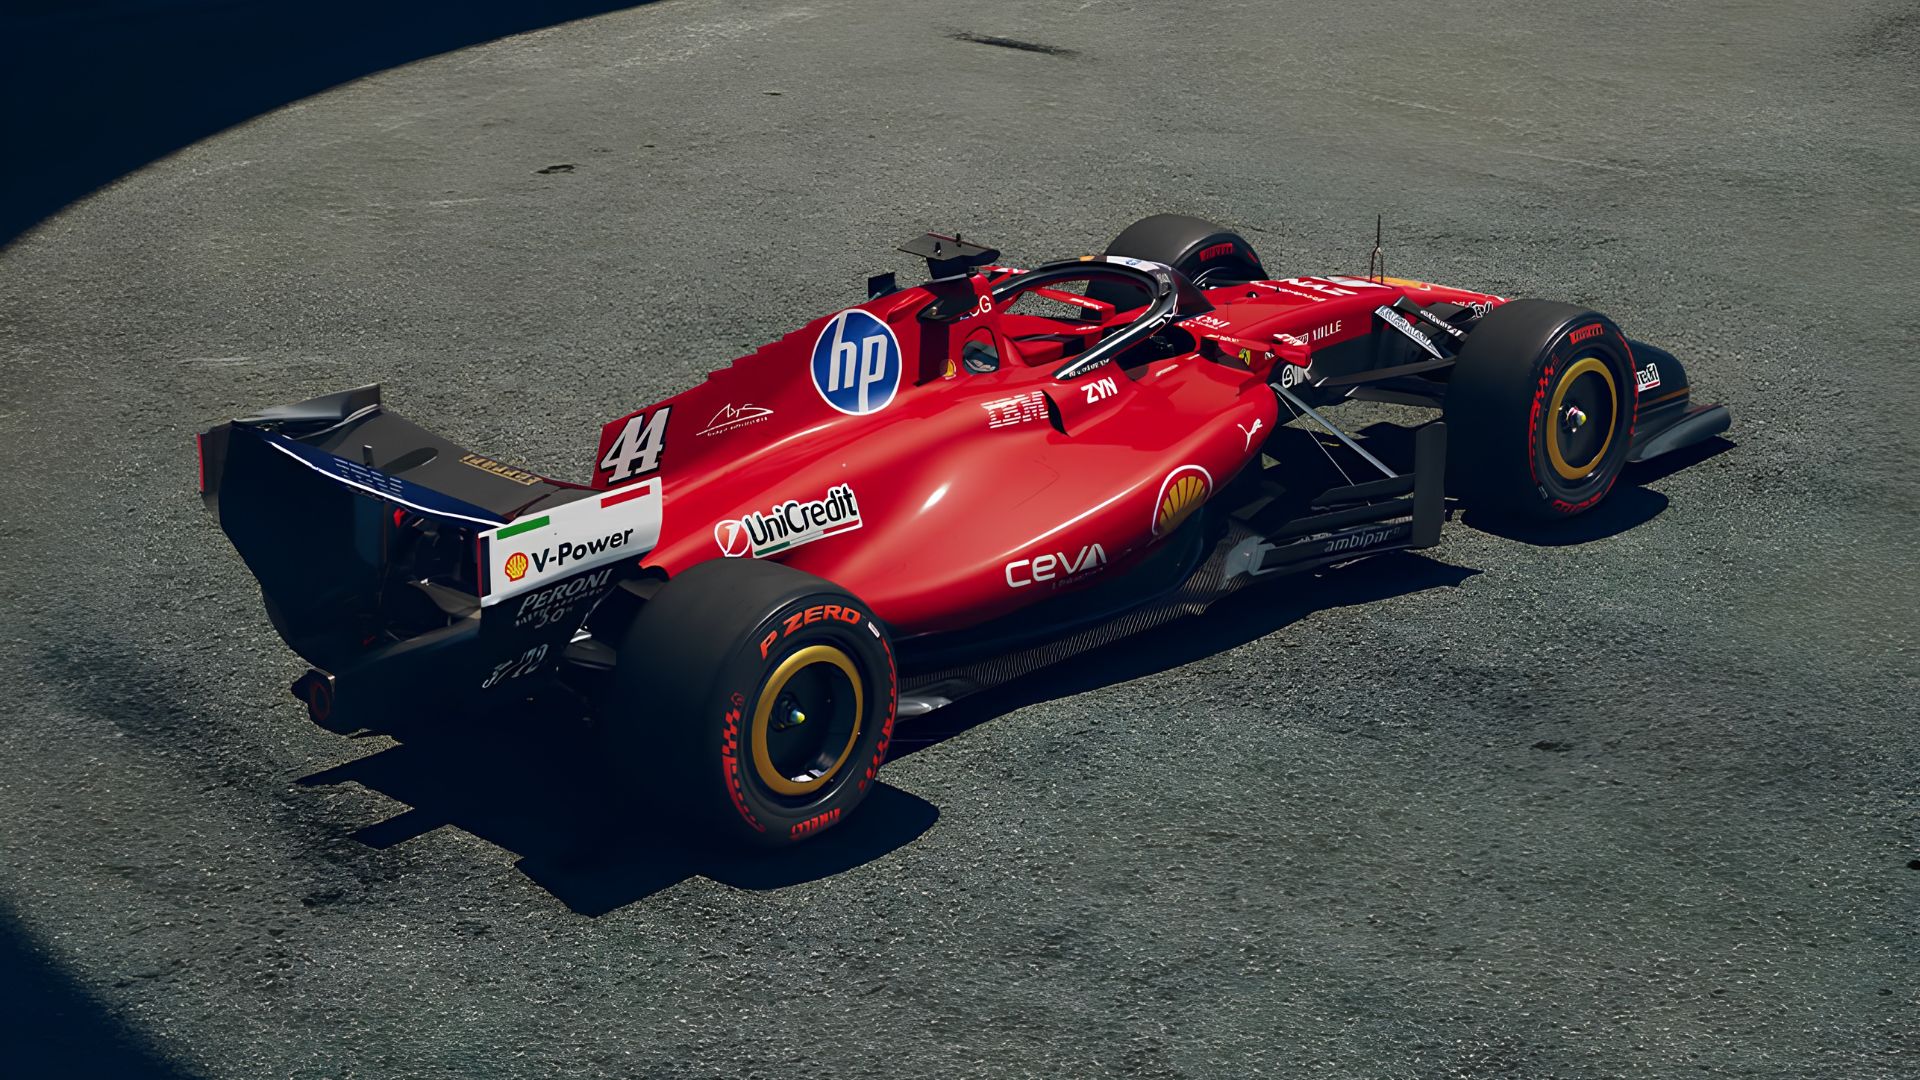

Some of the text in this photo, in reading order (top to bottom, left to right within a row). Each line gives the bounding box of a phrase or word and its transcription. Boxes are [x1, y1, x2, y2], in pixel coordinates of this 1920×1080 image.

[828, 310, 889, 413] hp
[980, 390, 1049, 429] IBM
[1080, 376, 1119, 404] ZYN
[600, 405, 672, 484] 44
[744, 485, 858, 546] UniCredit
[531, 528, 634, 573] V-Power
[1324, 529, 1393, 553] ambipar
[517, 568, 613, 617] PERONI
[760, 630, 778, 660] P
